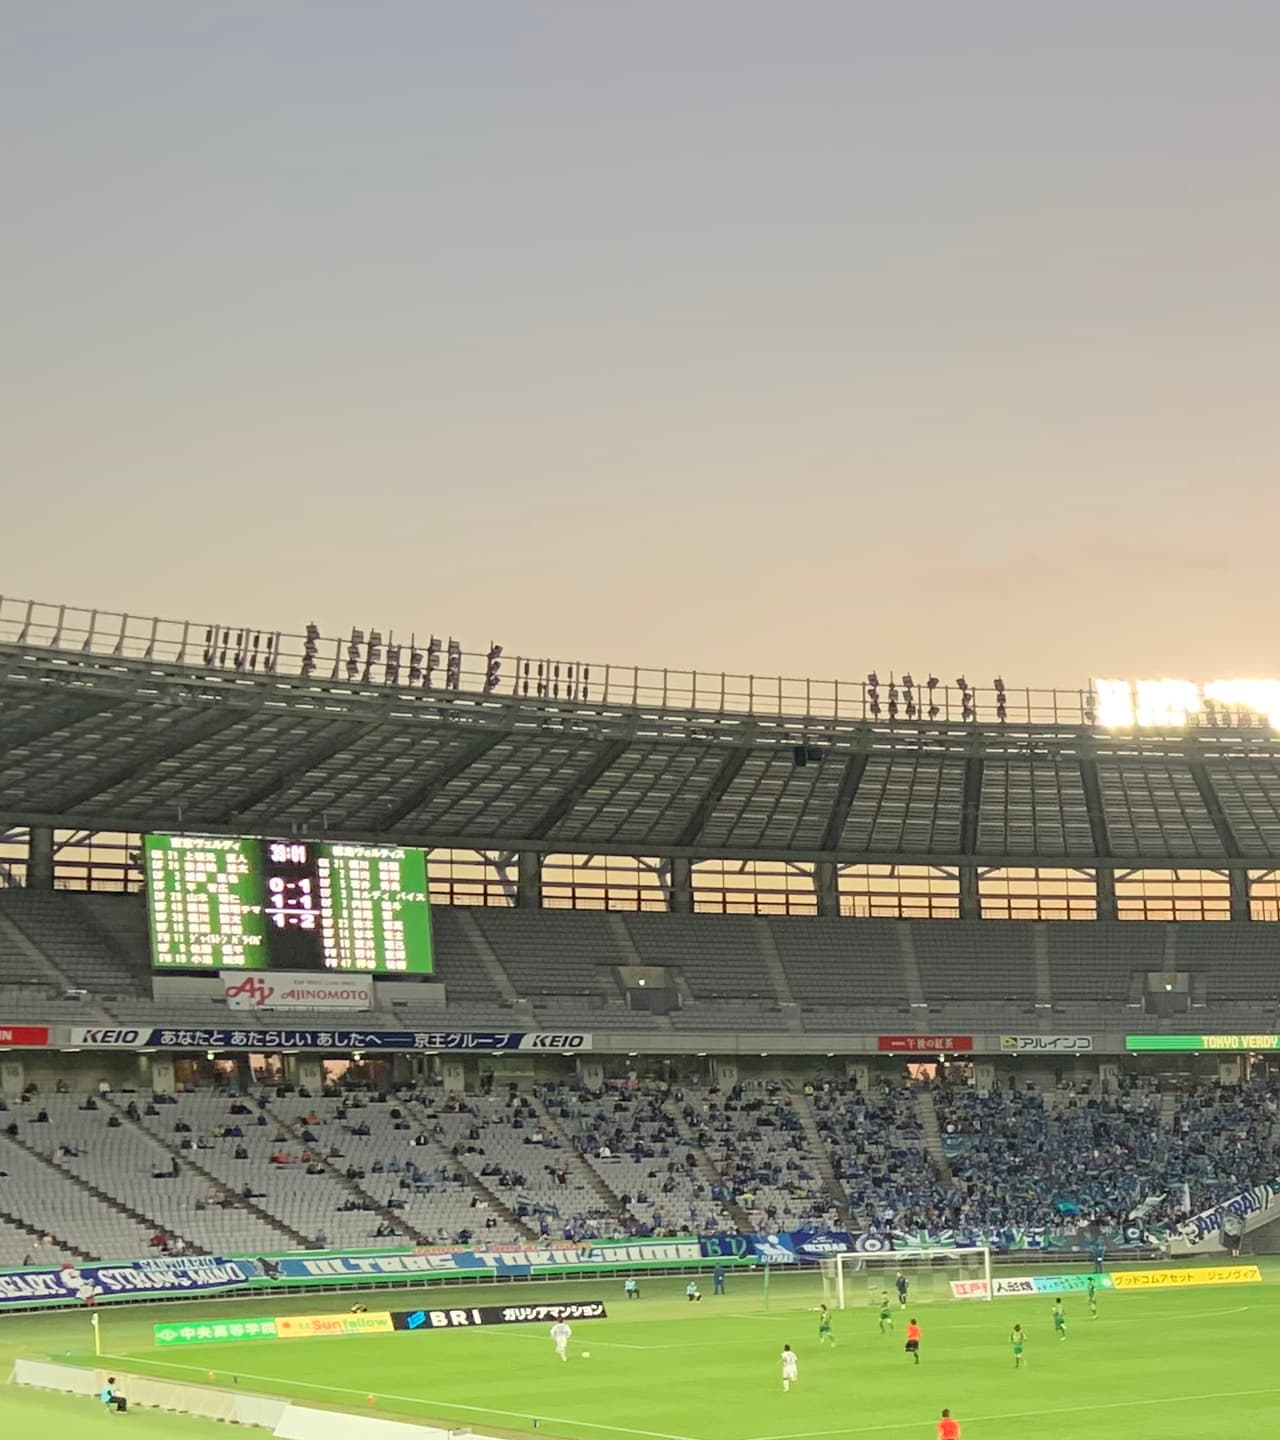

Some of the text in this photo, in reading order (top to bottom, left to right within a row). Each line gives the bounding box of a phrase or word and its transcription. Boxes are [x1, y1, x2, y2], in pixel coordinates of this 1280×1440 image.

[280, 989, 368, 1000] AJINOMOTO
[82, 1029, 140, 1044] KEIO
[160, 1030, 225, 1046] あなたと
[231, 1030, 312, 1046] あたらしい
[414, 1032, 510, 1048] 京王グループ
[532, 1035, 584, 1048] KEIO
[1019, 1037, 1092, 1048] アルインコ
[1202, 1036, 1238, 1048] TOKYO
[1240, 1035, 1278, 1048] VERDY
[1114, 1270, 1258, 1286] グッドコムアセット ジェノヴィア
[429, 1304, 603, 1327] BRI ガリシアマンション
